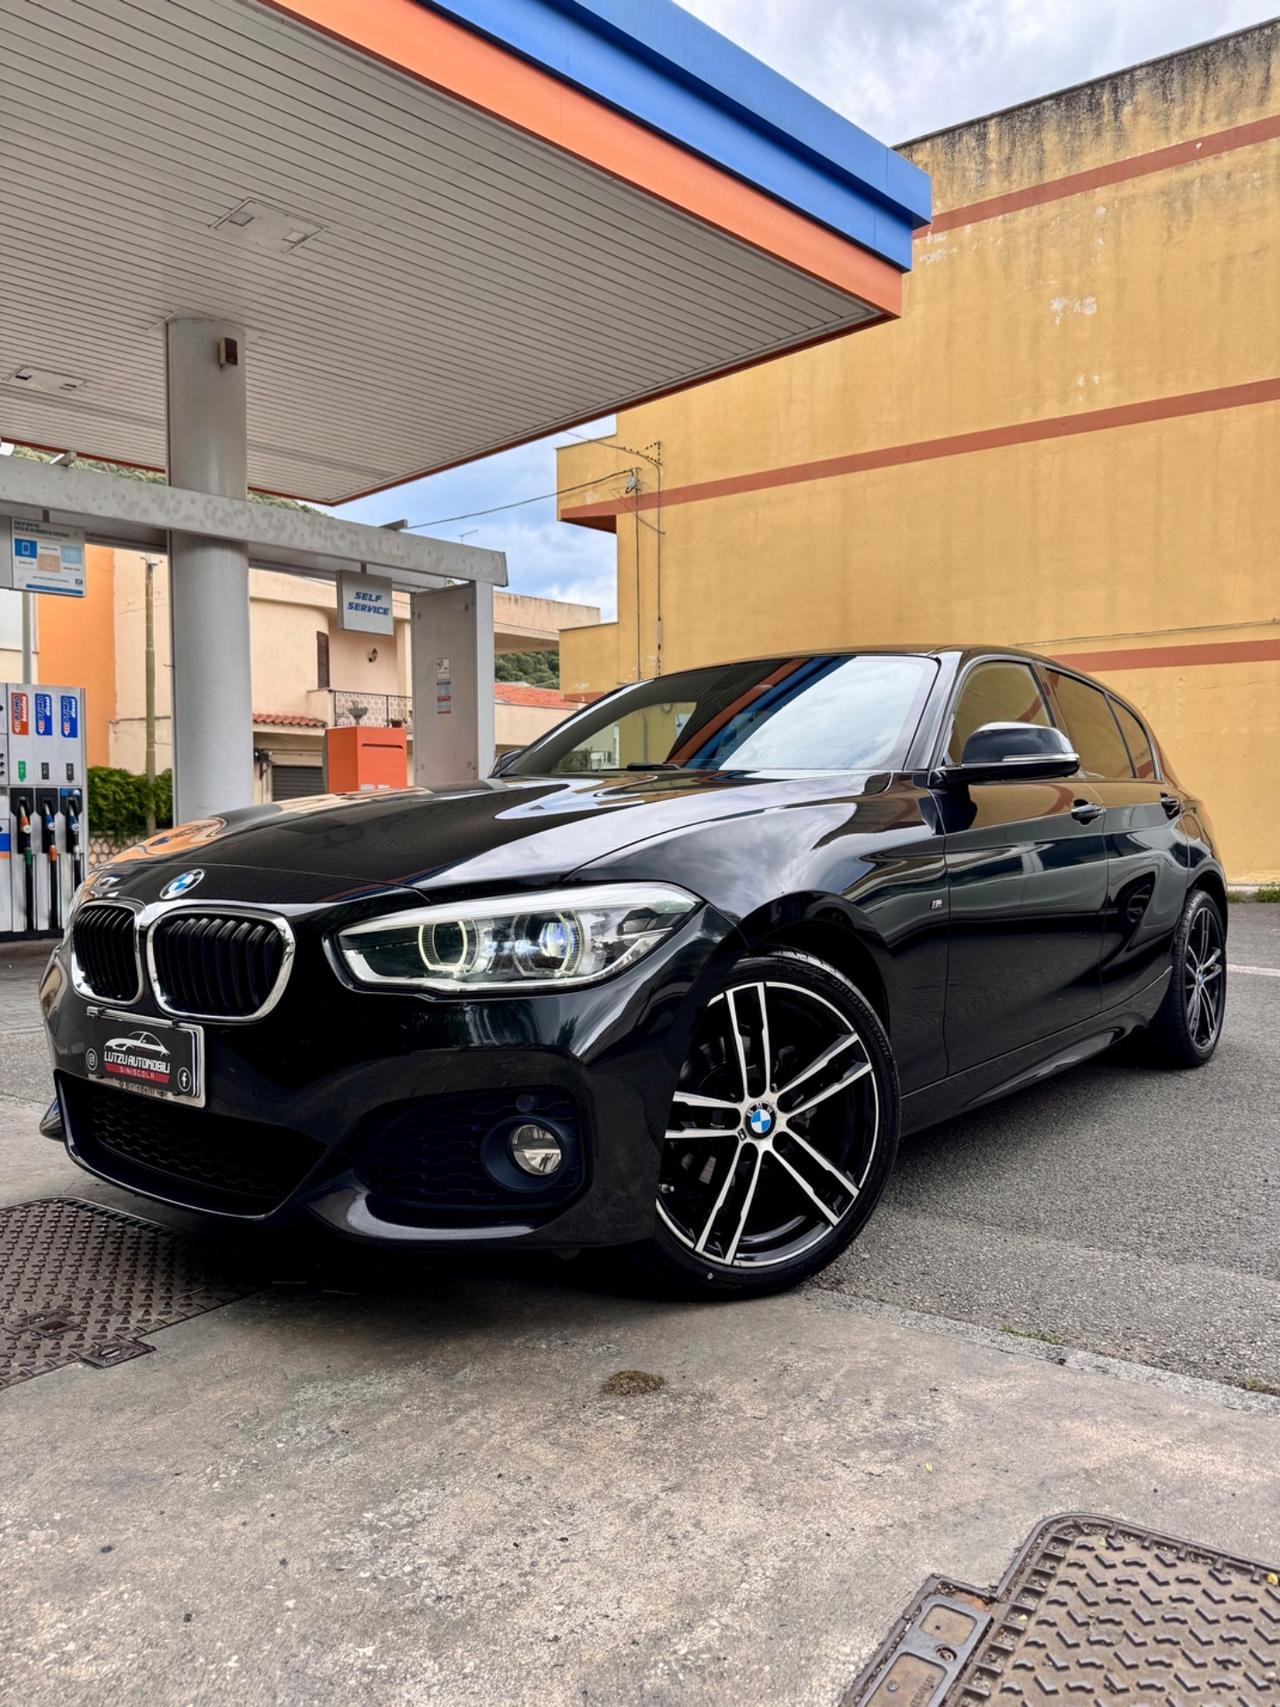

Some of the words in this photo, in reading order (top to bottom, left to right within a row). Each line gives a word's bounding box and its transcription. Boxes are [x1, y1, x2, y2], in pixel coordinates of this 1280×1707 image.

[354, 592, 383, 602] SELF
[347, 602, 390, 616] SERVICE
[104, 1051, 128, 1065] LUTZU
[128, 1055, 170, 1074] AUTOMOBILI
[120, 1066, 155, 1079] SINISCOLA
